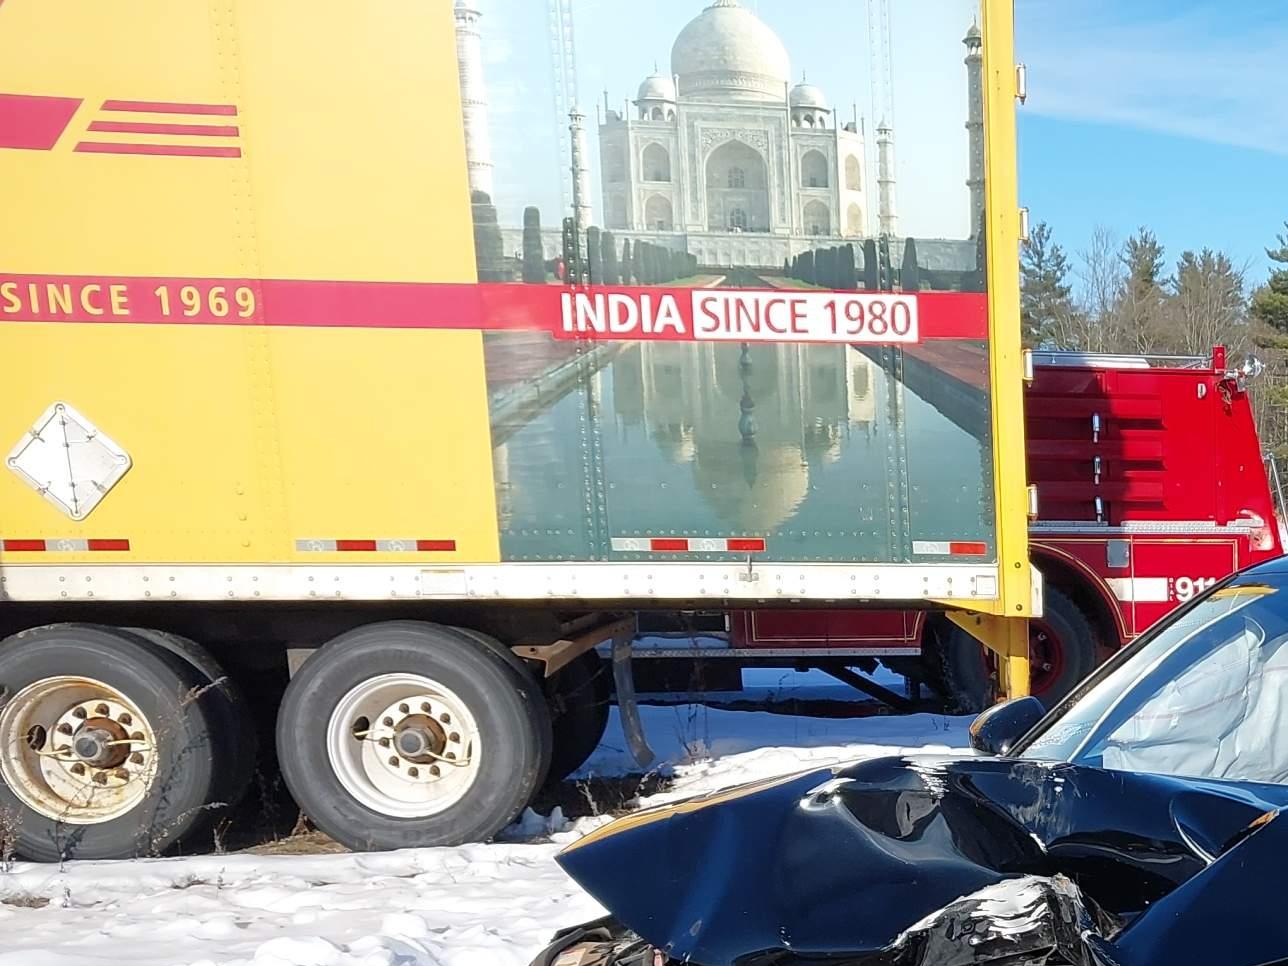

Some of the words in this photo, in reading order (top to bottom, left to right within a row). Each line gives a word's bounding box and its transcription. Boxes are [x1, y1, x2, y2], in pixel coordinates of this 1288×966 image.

[0, 281, 131, 316] SINCE
[154, 285, 257, 318] 1969
[560, 292, 687, 335] INDIA
[700, 295, 810, 335] SINCE
[823, 299, 912, 337] 1980
